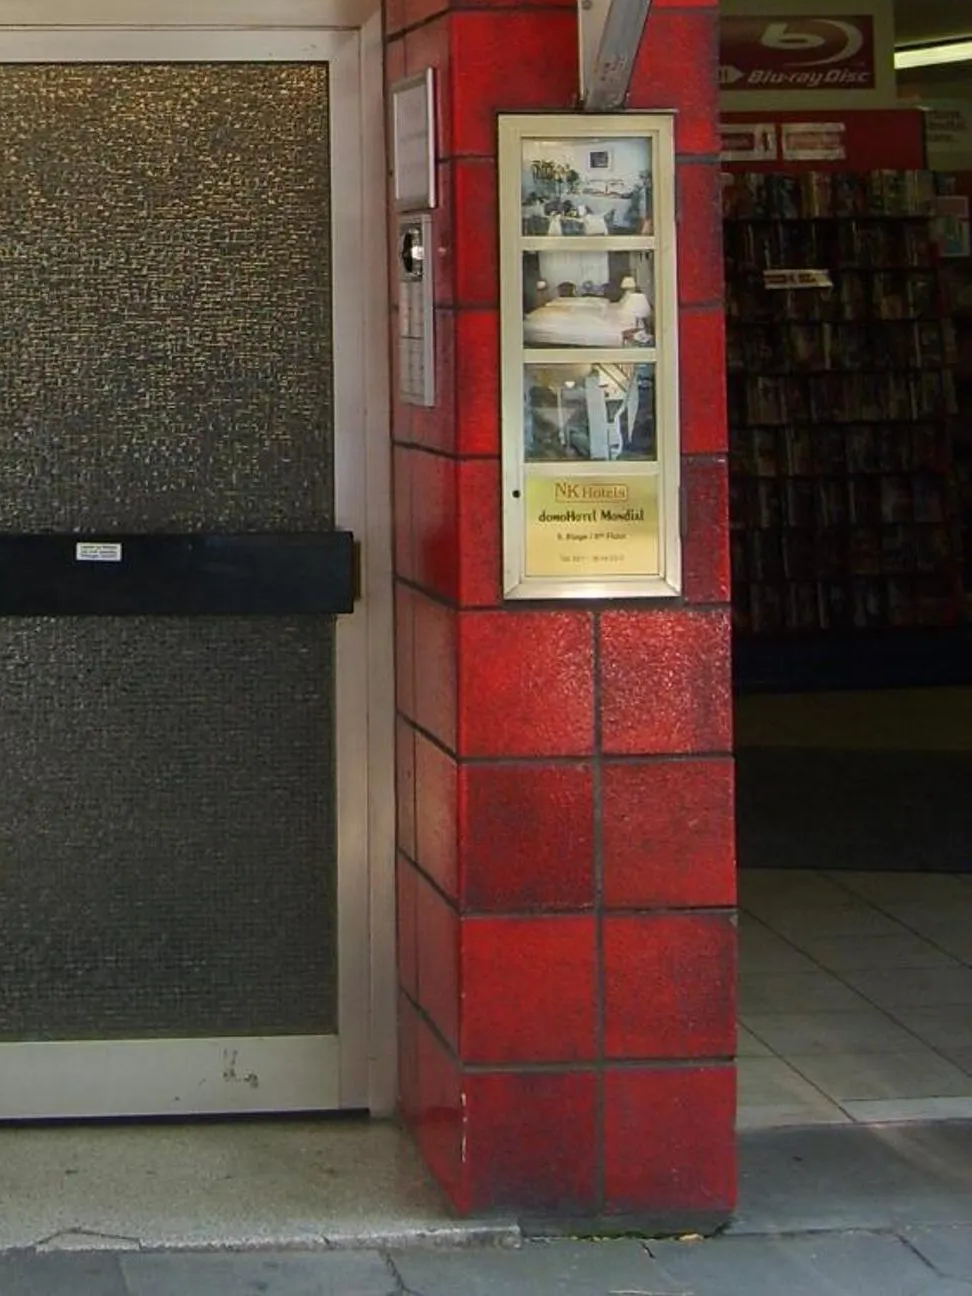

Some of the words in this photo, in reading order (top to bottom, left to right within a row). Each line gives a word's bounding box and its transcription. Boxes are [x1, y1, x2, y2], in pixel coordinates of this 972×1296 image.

[555, 482, 580, 500] NK
[582, 484, 627, 500] Hotels
[600, 507, 645, 522] Mondial
